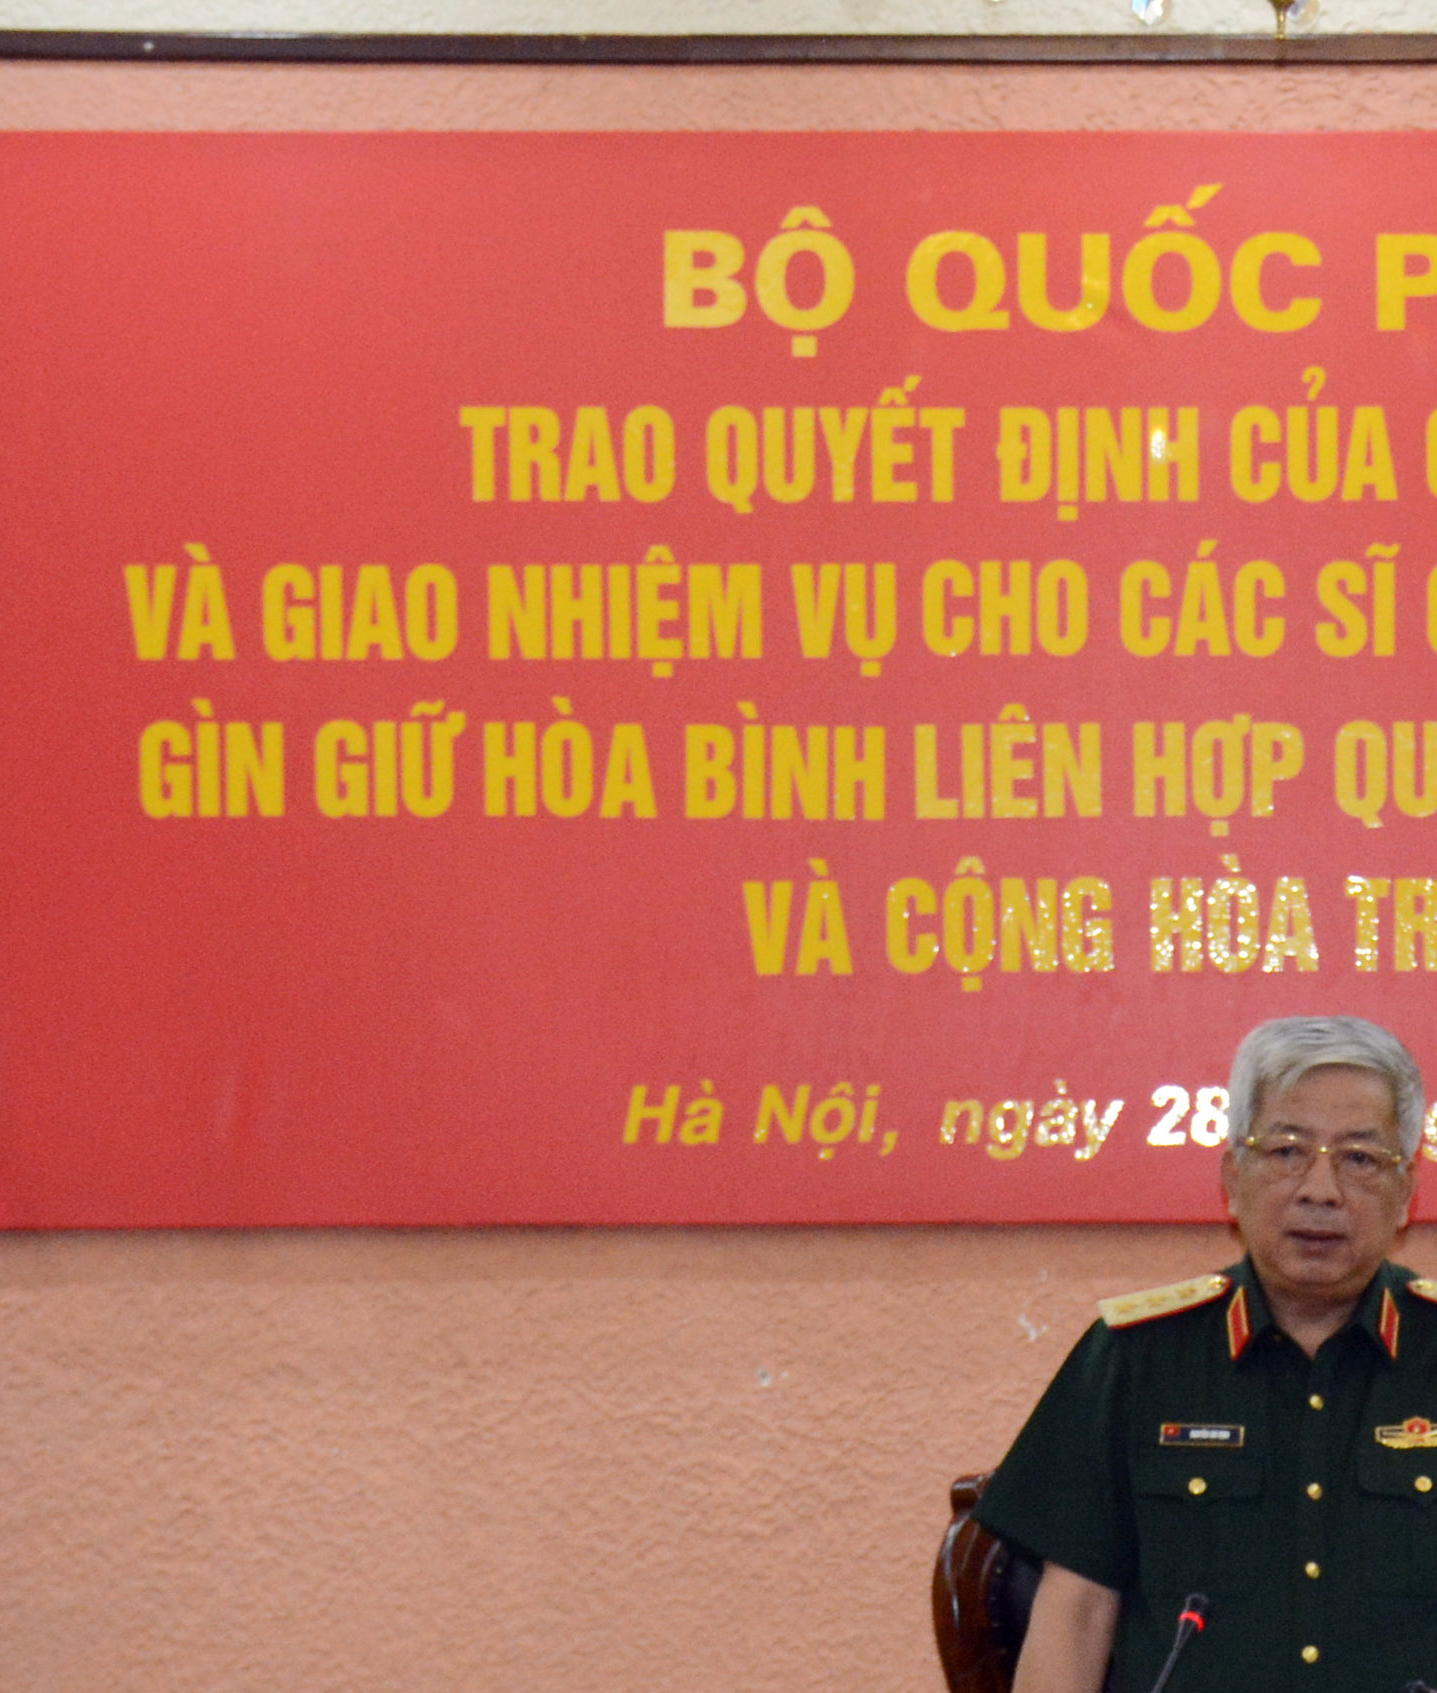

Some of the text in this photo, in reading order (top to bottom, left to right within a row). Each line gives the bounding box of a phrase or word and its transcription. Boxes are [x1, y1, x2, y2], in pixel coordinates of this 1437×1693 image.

[663, 206, 855, 358] BỘ
[905, 182, 1323, 333] QUỐC
[460, 404, 675, 503] TRAO
[705, 374, 966, 514] QUYẾT
[996, 406, 1200, 522] ĐỊNH
[1230, 365, 1398, 503] CỦA
[125, 543, 235, 660] VÀ
[263, 563, 458, 661] GIAO
[488, 544, 763, 678] NHIỆM
[791, 562, 897, 677] VỤ
[923, 559, 1089, 657] CHO
[1120, 539, 1286, 658] CÁC
[1316, 542, 1401, 658] SĨ
[140, 699, 284, 818] GÌN
[315, 700, 466, 818] GIỮ
[484, 696, 657, 818] HÒA
[685, 701, 886, 821] BÌNH
[914, 703, 1102, 819] LIÊN
[1133, 712, 1305, 837] HỢP
[743, 858, 853, 976] VÀ
[886, 856, 1113, 992] CỘNG
[1149, 855, 1320, 974] HÒA
[623, 1079, 723, 1145] Hà
[754, 1082, 898, 1160] Nội,
[940, 1080, 1124, 1162] ngày
[1147, 1085, 1230, 1148] 28
